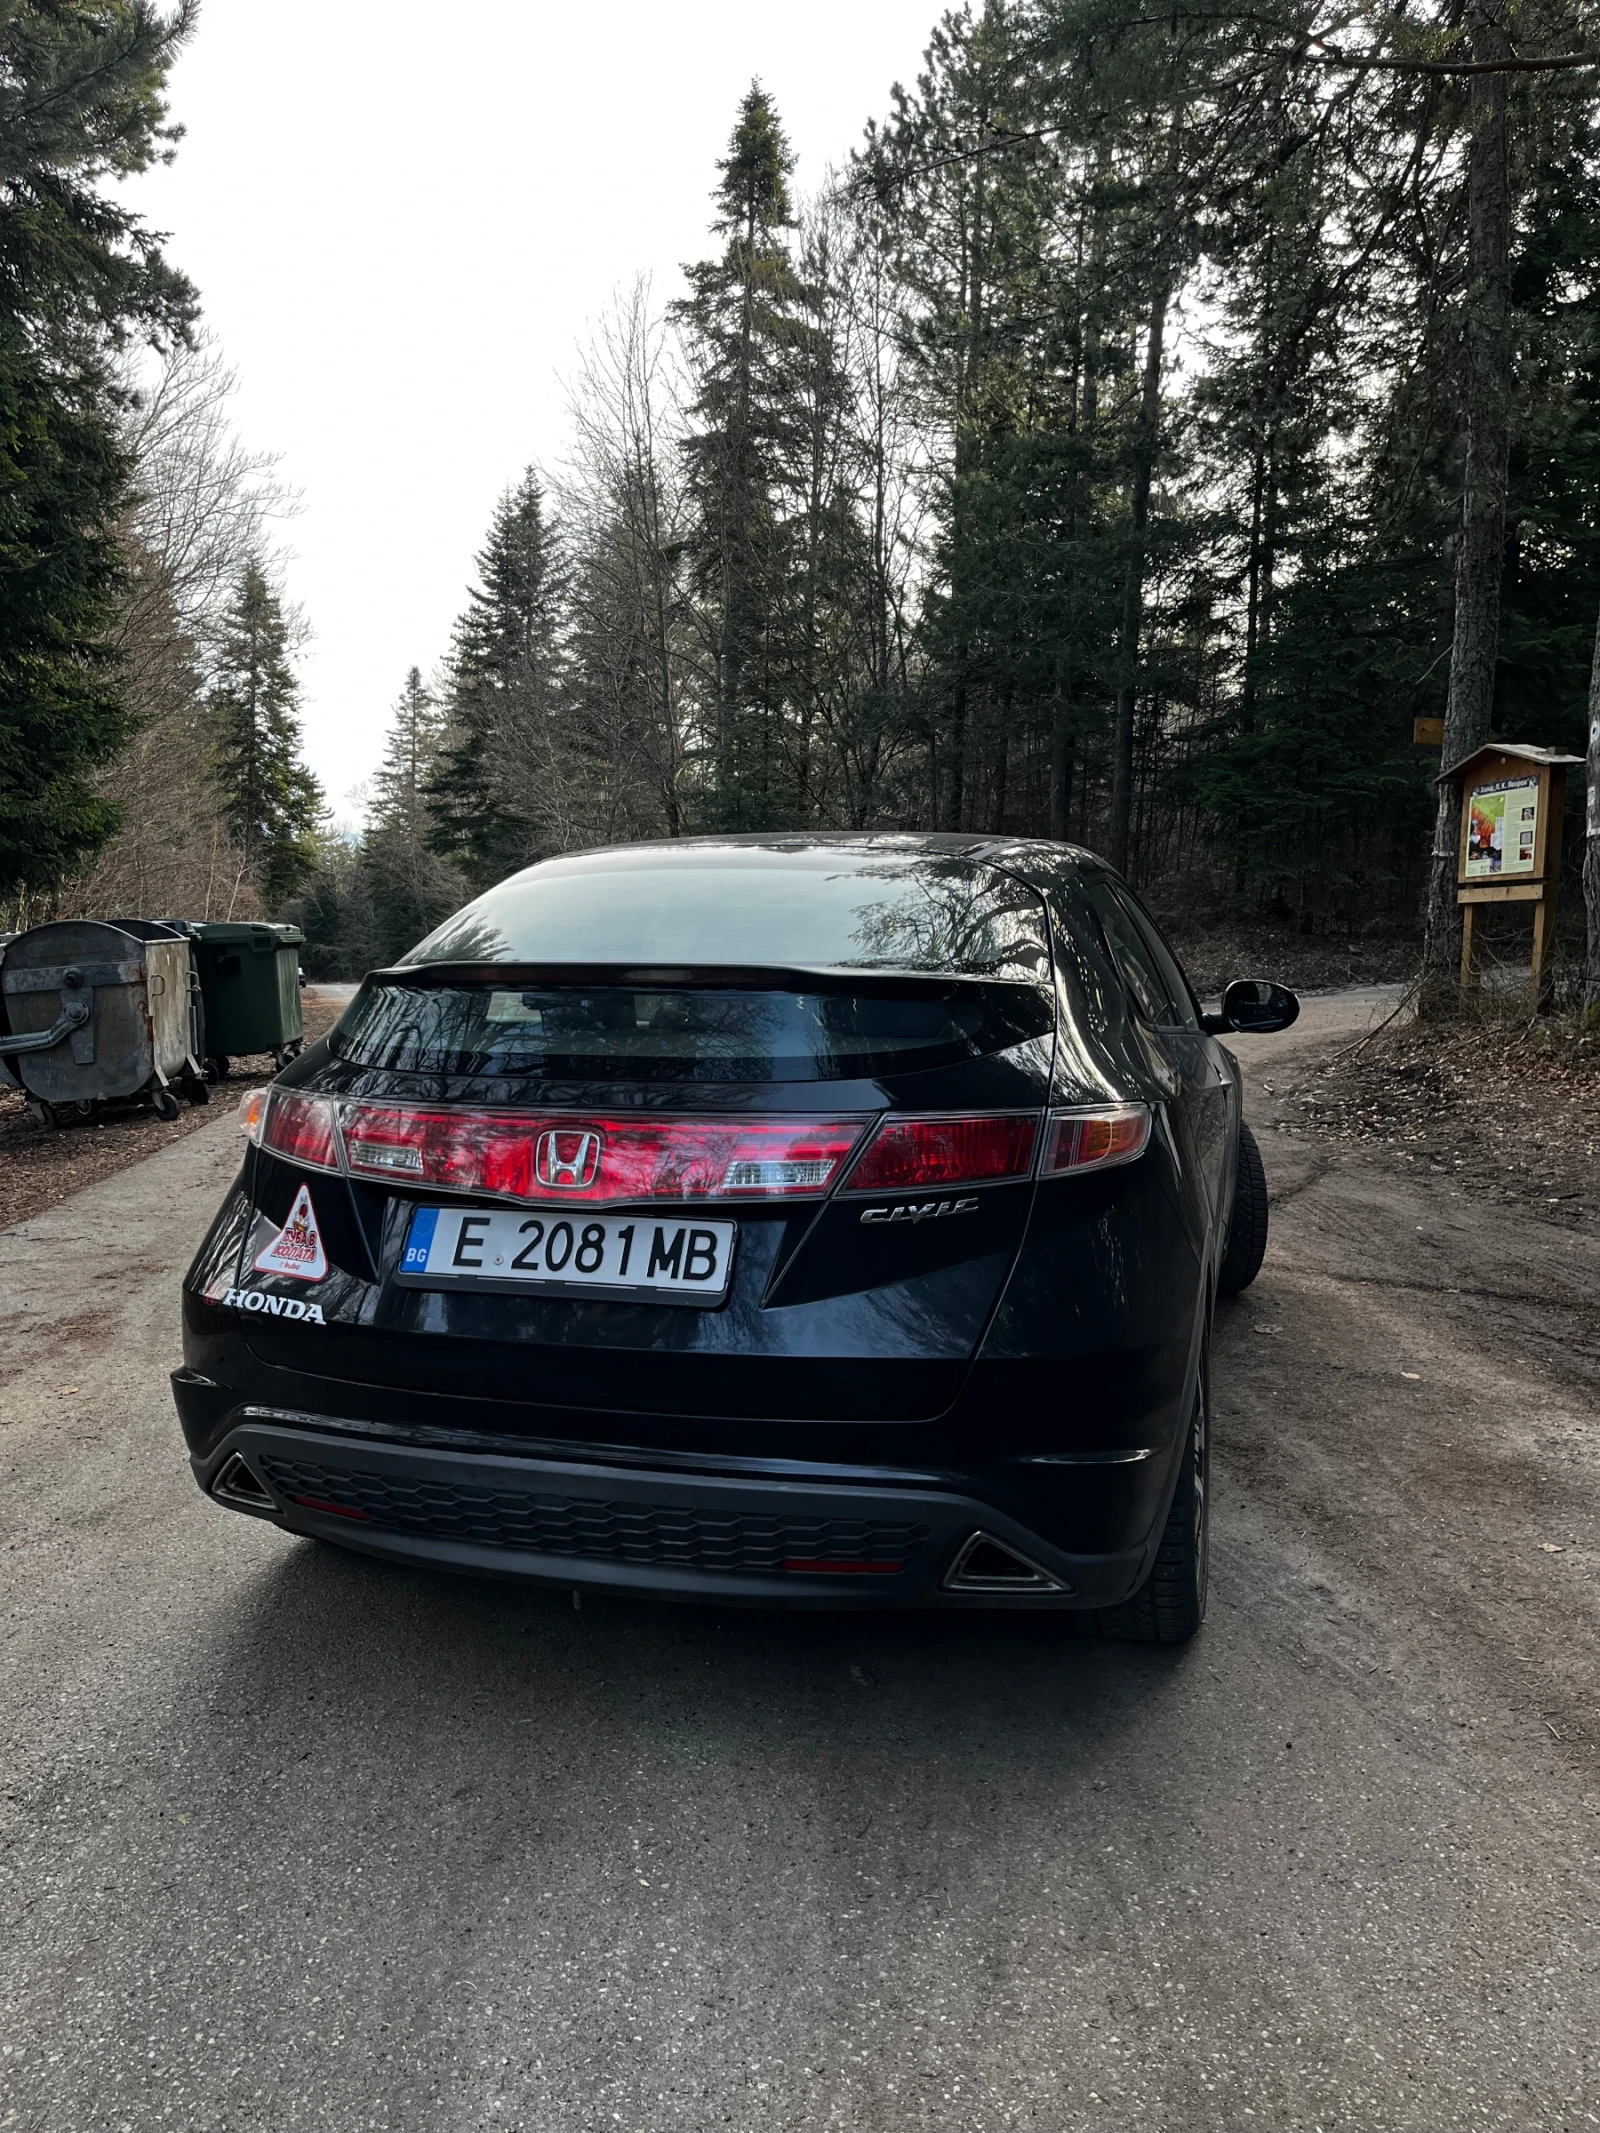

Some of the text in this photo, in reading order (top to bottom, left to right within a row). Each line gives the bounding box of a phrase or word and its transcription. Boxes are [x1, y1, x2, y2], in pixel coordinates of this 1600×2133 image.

[860, 1197, 979, 1225] CIVIC
[282, 1229, 316, 1248] БУБА В
[452, 1217, 718, 1281] E 2081 MB
[272, 1244, 316, 1262] КОЛАТА
[405, 1247, 428, 1264] BG
[223, 1288, 326, 1325] HONDA
